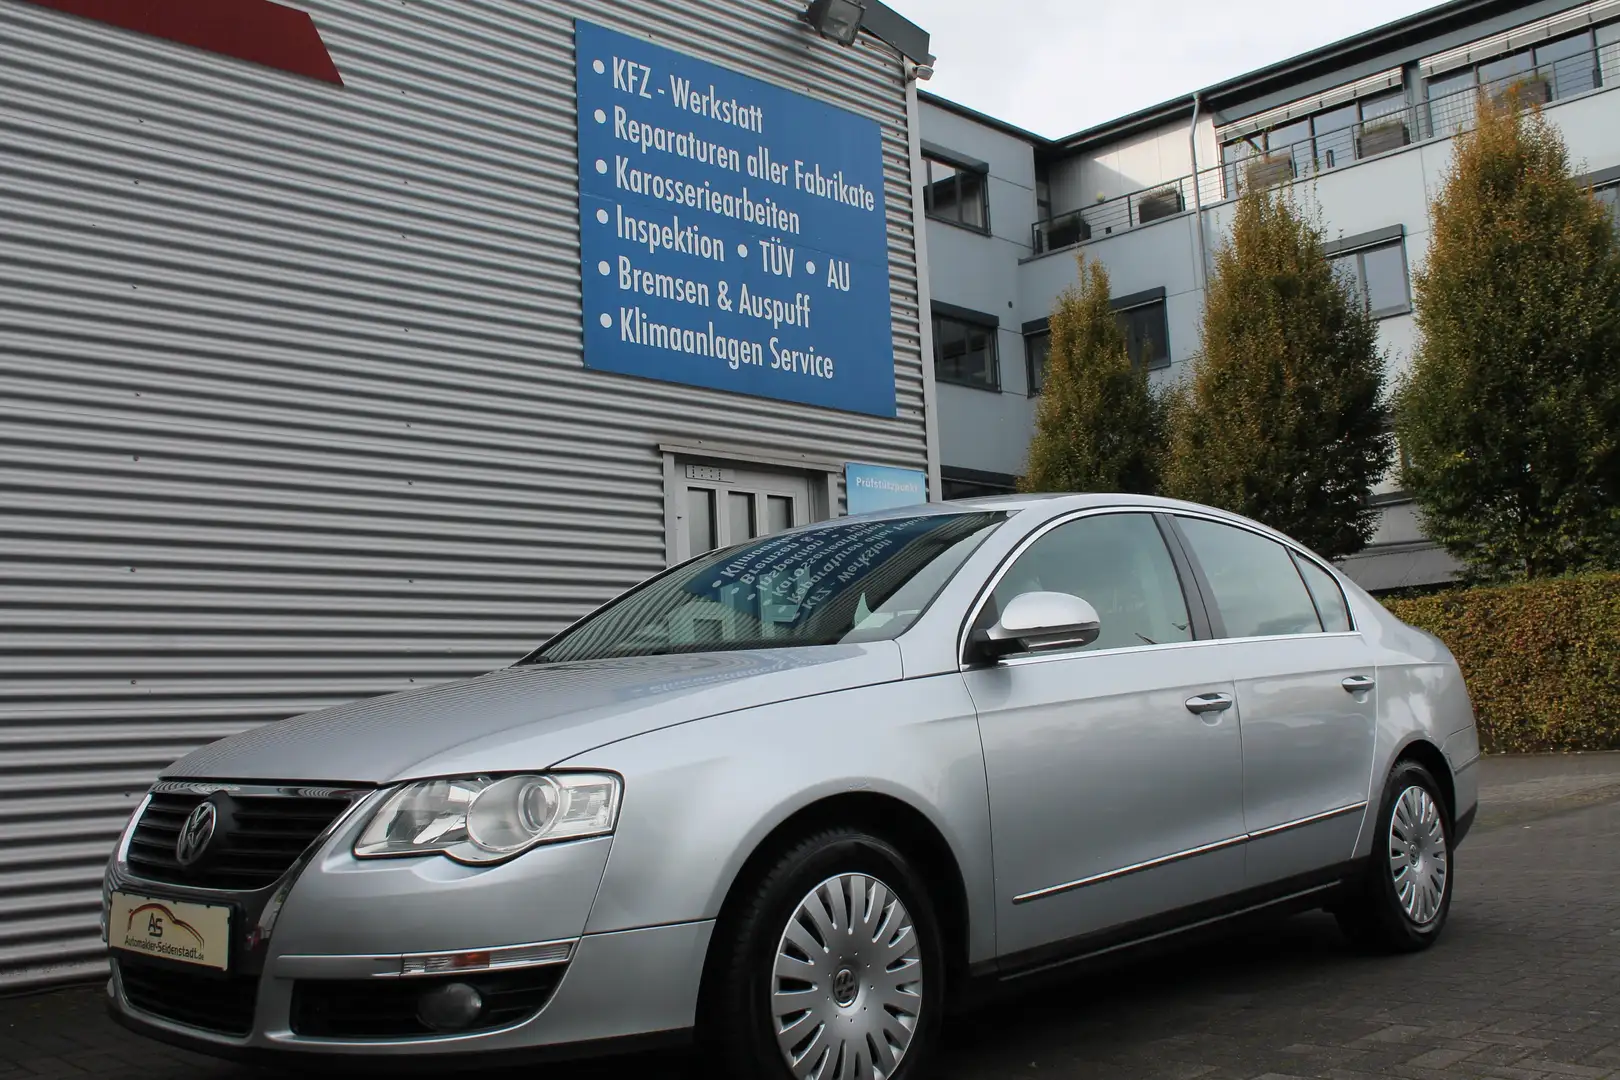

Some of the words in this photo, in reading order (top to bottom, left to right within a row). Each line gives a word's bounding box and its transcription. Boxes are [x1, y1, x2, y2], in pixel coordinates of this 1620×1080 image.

[612, 55, 652, 100] KFZ
[657, 88, 666, 96] -
[669, 74, 764, 134] Werkstatt
[614, 105, 740, 173] Reparaturen
[747, 145, 789, 187] aller
[794, 159, 875, 212] Fabrikate
[615, 154, 800, 235] Karosseriearbeiten
[616, 204, 725, 262] Inspektion
[759, 236, 795, 278] TÜV
[827, 258, 850, 292] AU
[618, 255, 709, 307] Bremsen
[717, 280, 733, 312] &
[739, 283, 811, 329] Auspuff
[620, 306, 763, 371] Klimaanlagen
[769, 337, 834, 380] Service
[148, 912, 163, 937] AS
